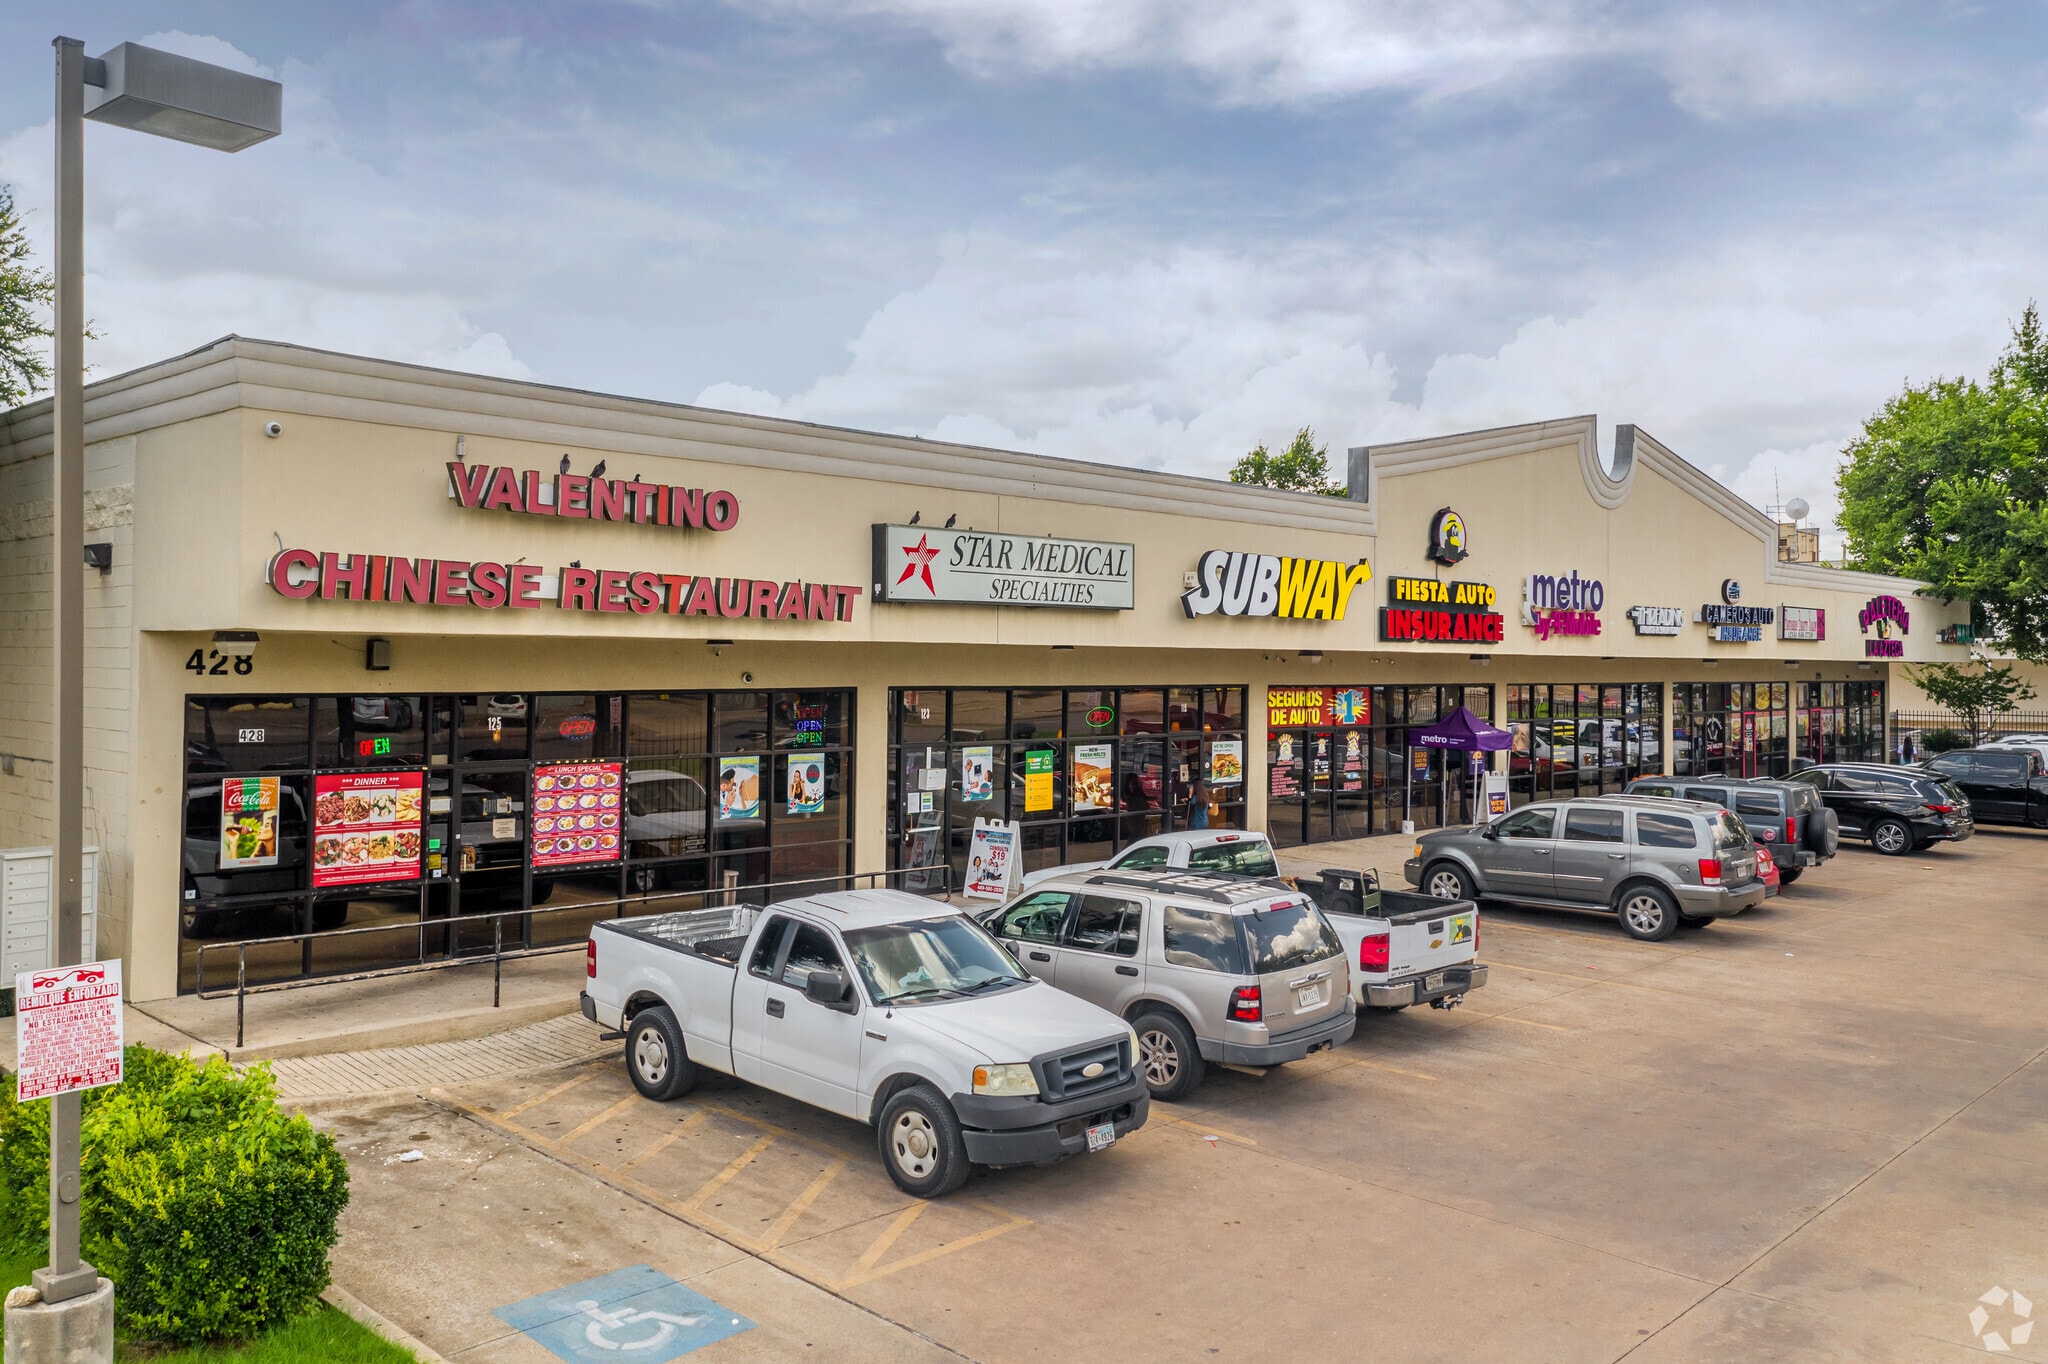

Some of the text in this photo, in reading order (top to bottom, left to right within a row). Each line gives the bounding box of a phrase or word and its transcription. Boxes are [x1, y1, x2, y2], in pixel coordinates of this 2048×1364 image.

[447, 462, 739, 531] VALENTINO
[949, 535, 1128, 577] STAR MEDICAL
[269, 548, 863, 623] CHINESE RESTAURANT
[989, 578, 1095, 604] SPECIALTIES
[1182, 549, 1373, 620] SUBWAY
[1396, 579, 1496, 606] FIESTA AUTO
[1532, 570, 1604, 612] metro
[1706, 604, 1774, 625] CAMERO'S AUTO
[1387, 609, 1504, 641] INSURANCE
[1720, 626, 1762, 642] INSURANCE
[1879, 640, 1904, 657] AZTECA
[185, 648, 253, 675] 428
[1268, 690, 1323, 708] SEGUROS
[797, 708, 823, 718] OPEN
[920, 708, 930, 720] 123
[1089, 711, 1111, 722] OPEN
[1271, 707, 1321, 726] DE AUTO
[487, 717, 502, 731] 125
[559, 719, 597, 735] OPEN
[796, 720, 823, 731] OPEN
[239, 729, 265, 742] 428
[796, 732, 823, 743] OPEN
[1421, 734, 1448, 745] metro
[360, 737, 391, 756] OPEN
[354, 777, 387, 786] DINNER
[228, 790, 274, 807] Coca-Cola
[992, 850, 1006, 861] $19
[20, 984, 117, 1009] REMOLQUE ENFORZADO
[87, 998, 107, 1006] CLIENTES
[88, 1003, 114, 1011] SOLAMENTE
[28, 1020, 38, 1028] NO
[42, 1011, 97, 1026] ESTACIONARSE
[29, 1070, 45, 1078] HORAS
[99, 1057, 119, 1065] SEMANA
